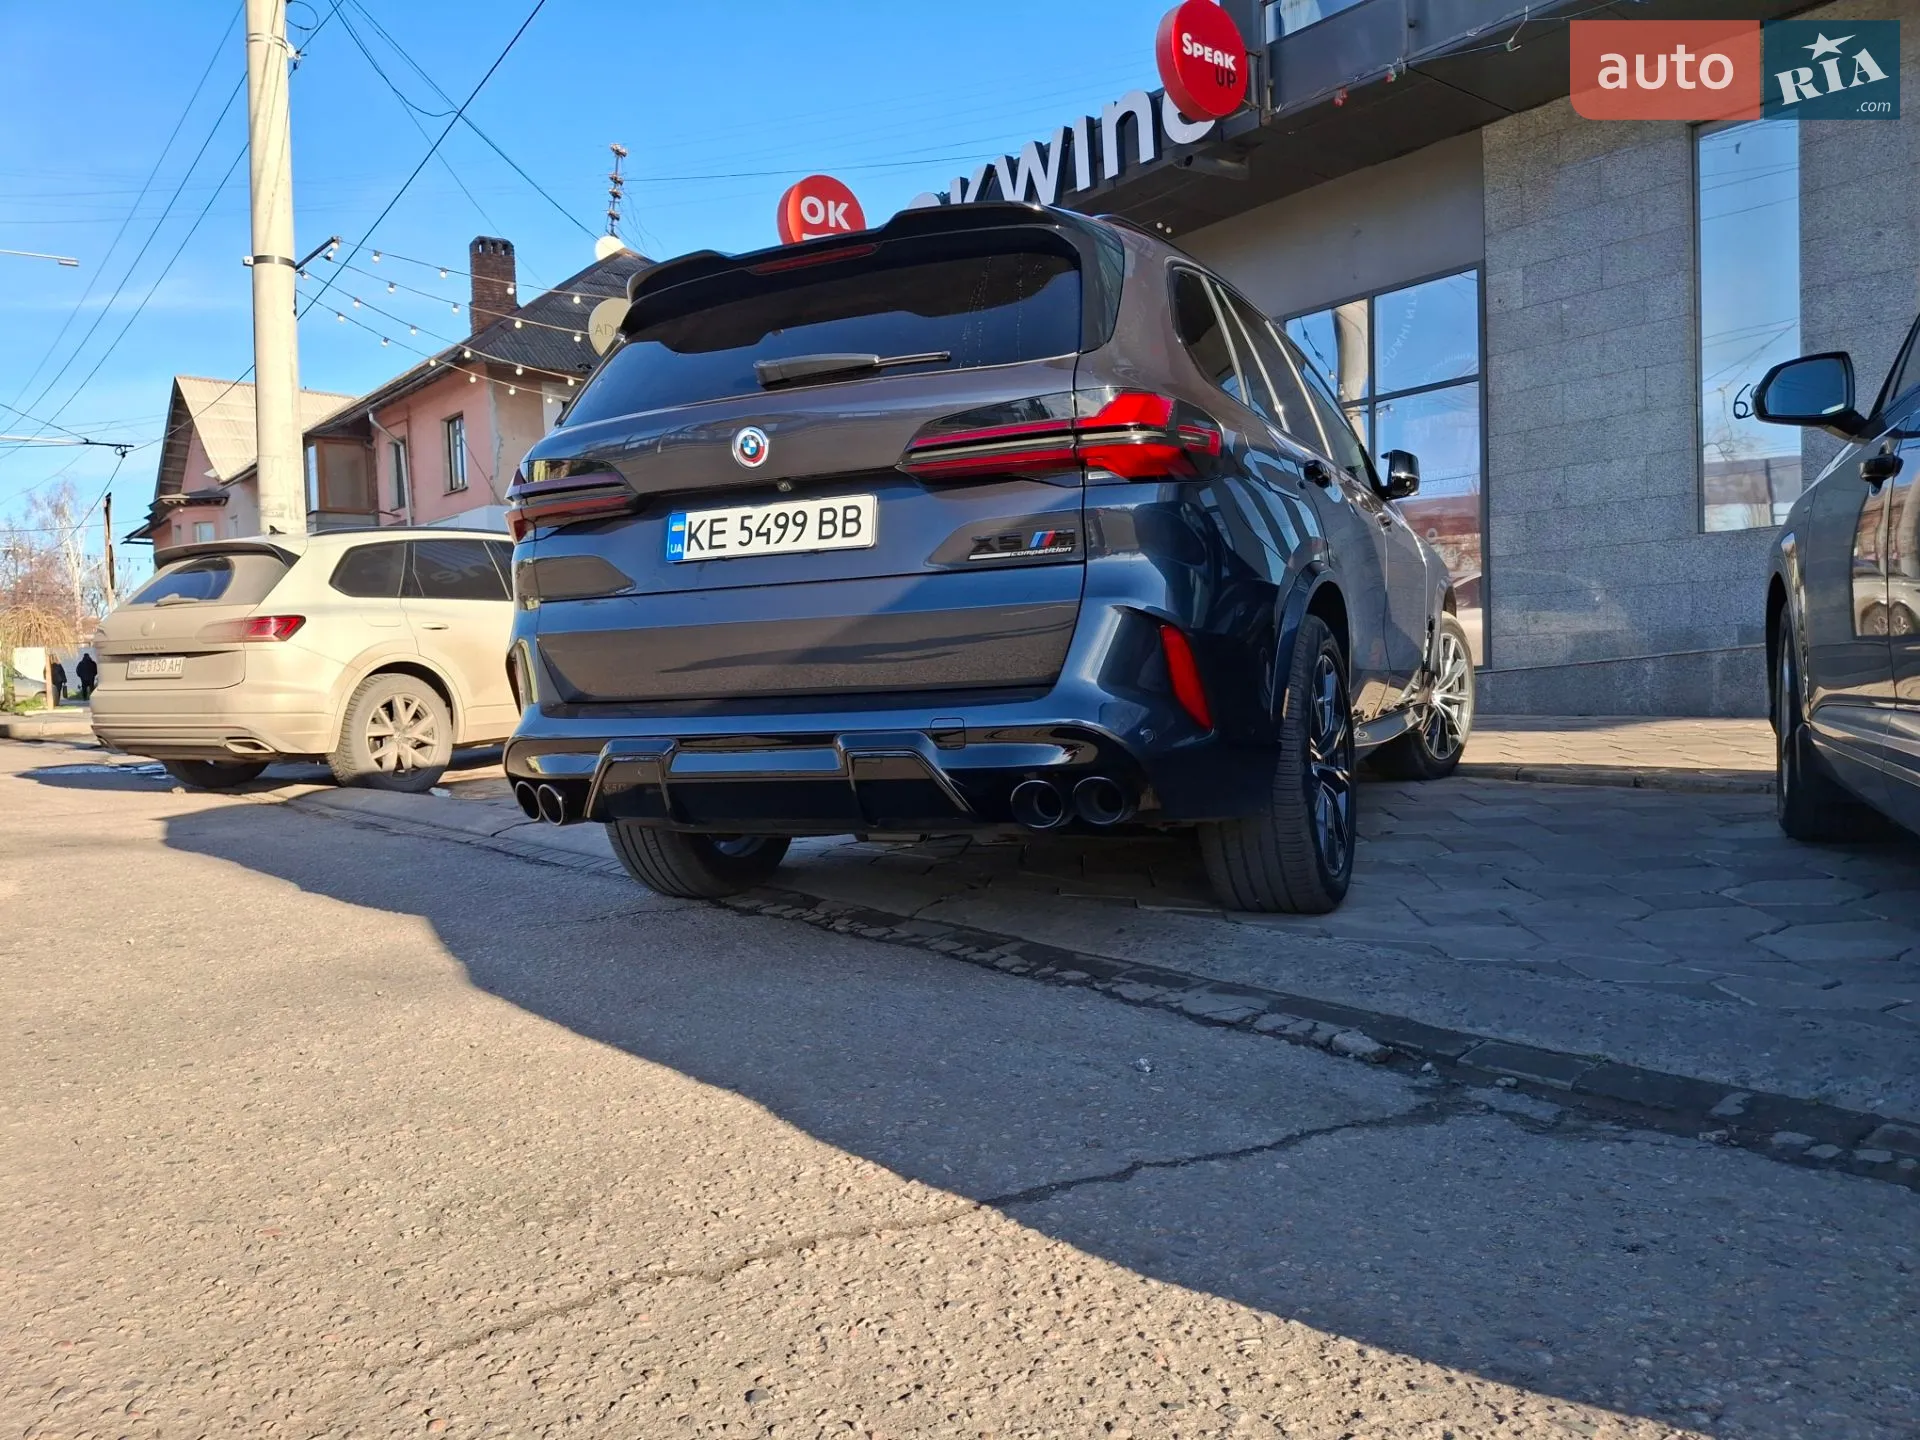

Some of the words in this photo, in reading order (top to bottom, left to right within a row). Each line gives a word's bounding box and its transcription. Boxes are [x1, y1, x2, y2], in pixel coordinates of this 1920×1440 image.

[800, 195, 851, 231] OK
[686, 517, 728, 553] KE
[738, 510, 809, 548] 5499
[818, 505, 862, 541] BB
[670, 543, 684, 554] UA
[1008, 546, 1072, 557] competition
